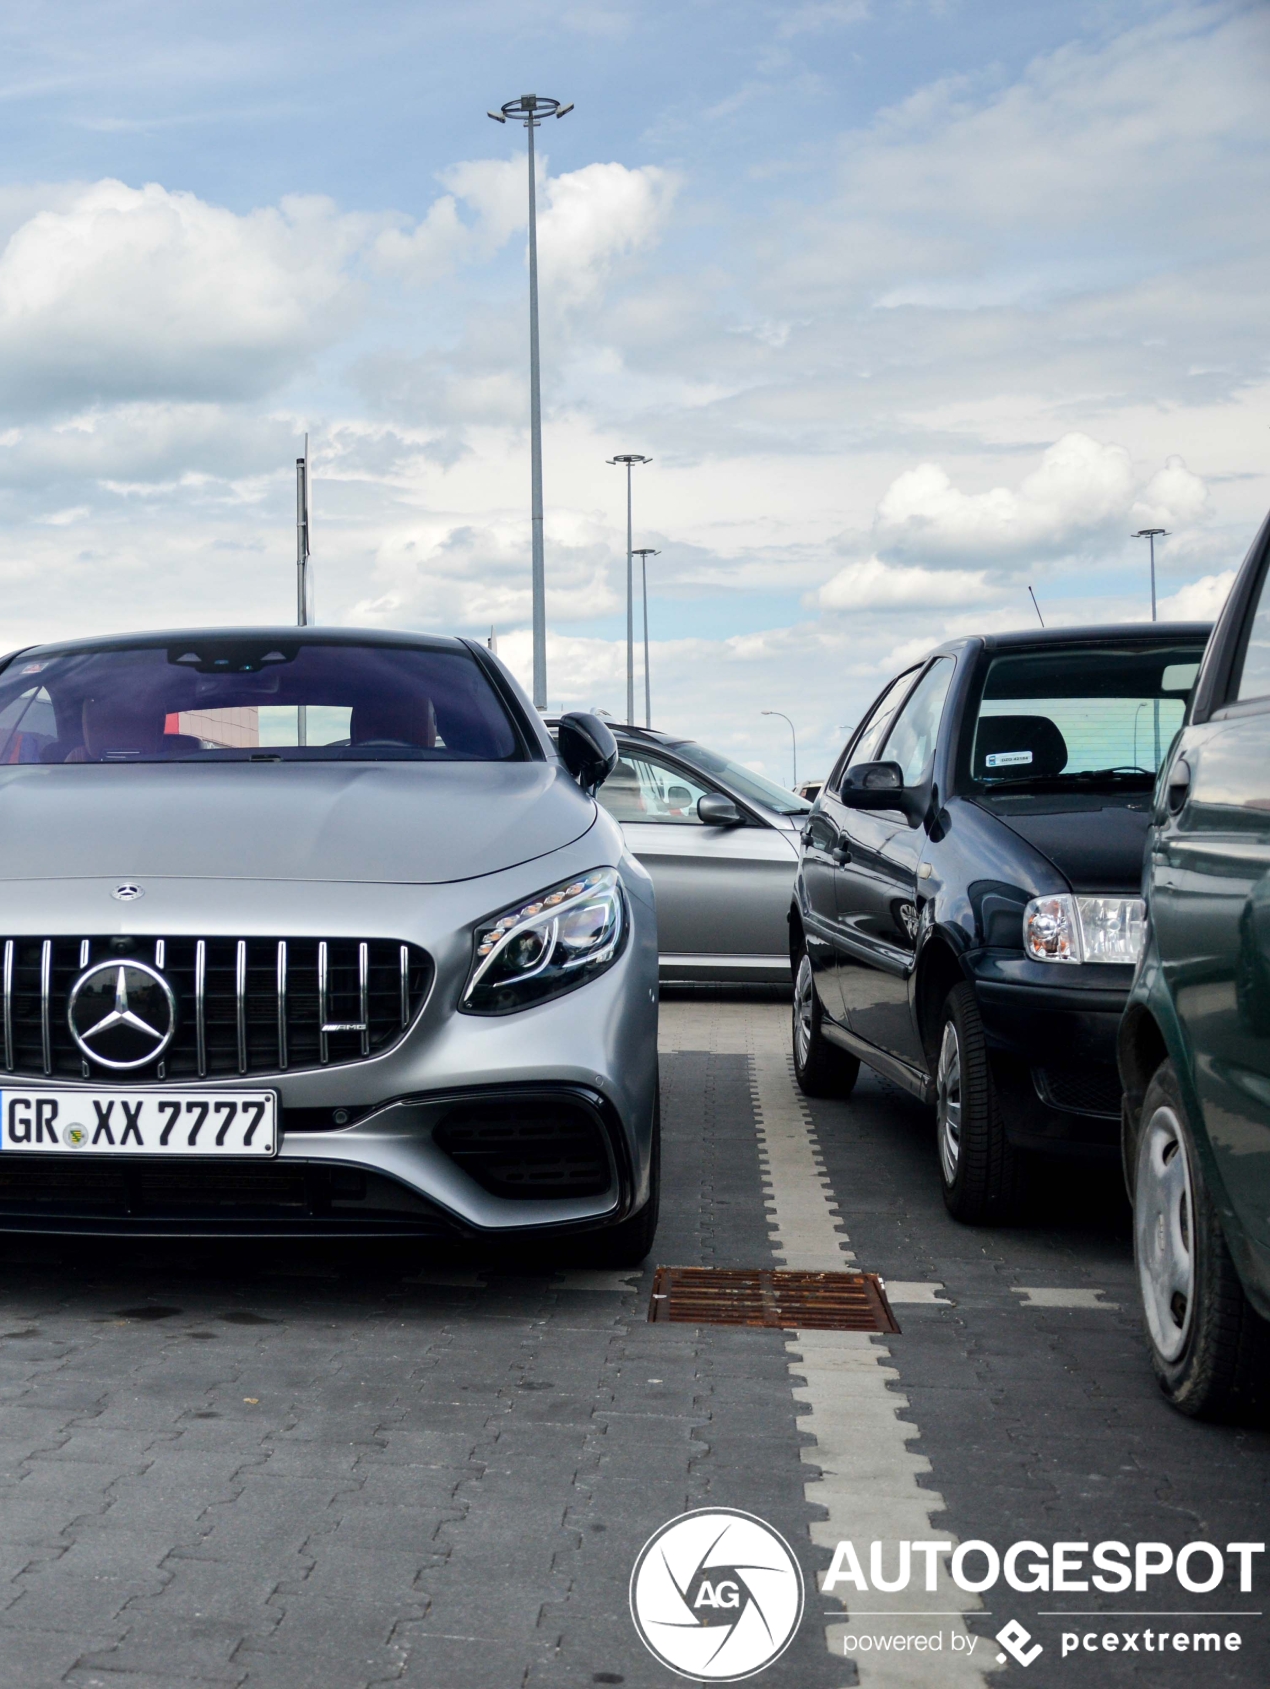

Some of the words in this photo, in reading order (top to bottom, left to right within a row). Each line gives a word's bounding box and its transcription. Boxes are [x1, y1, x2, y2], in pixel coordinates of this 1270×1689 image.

[8, 1098, 59, 1144] GR
[92, 1100, 144, 1146] XX
[158, 1101, 266, 1147] 7777
